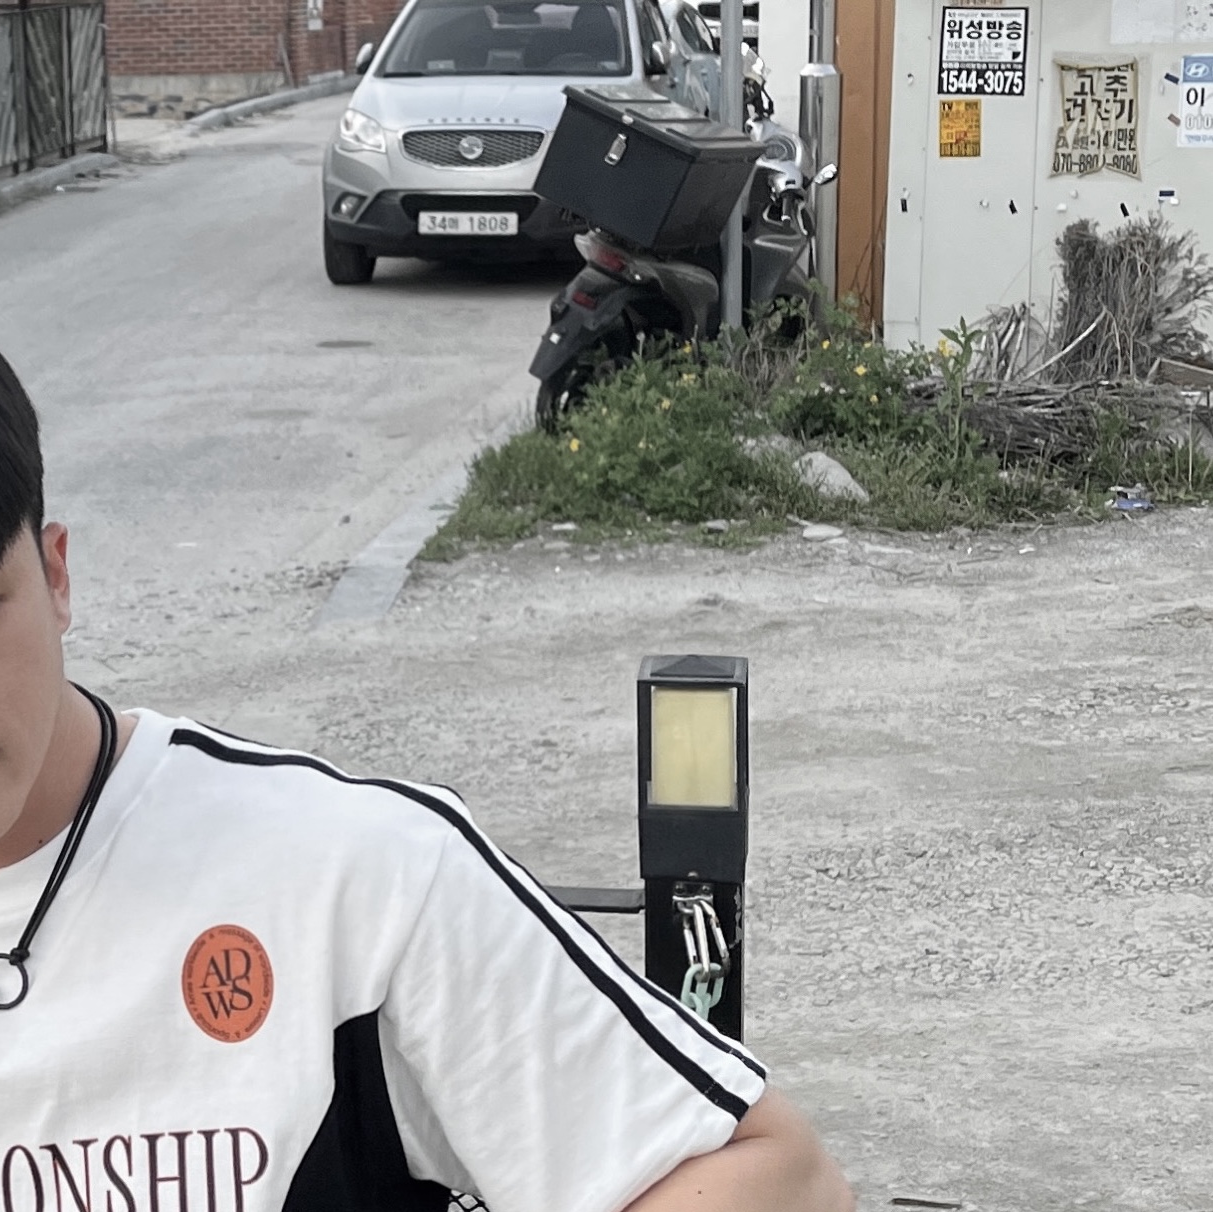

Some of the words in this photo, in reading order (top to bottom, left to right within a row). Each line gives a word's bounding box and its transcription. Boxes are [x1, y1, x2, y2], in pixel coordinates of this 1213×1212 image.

[947, 20, 1022, 40] 위성방송
[941, 69, 1023, 94] 1544-3075
[469, 215, 509, 232] 1808
